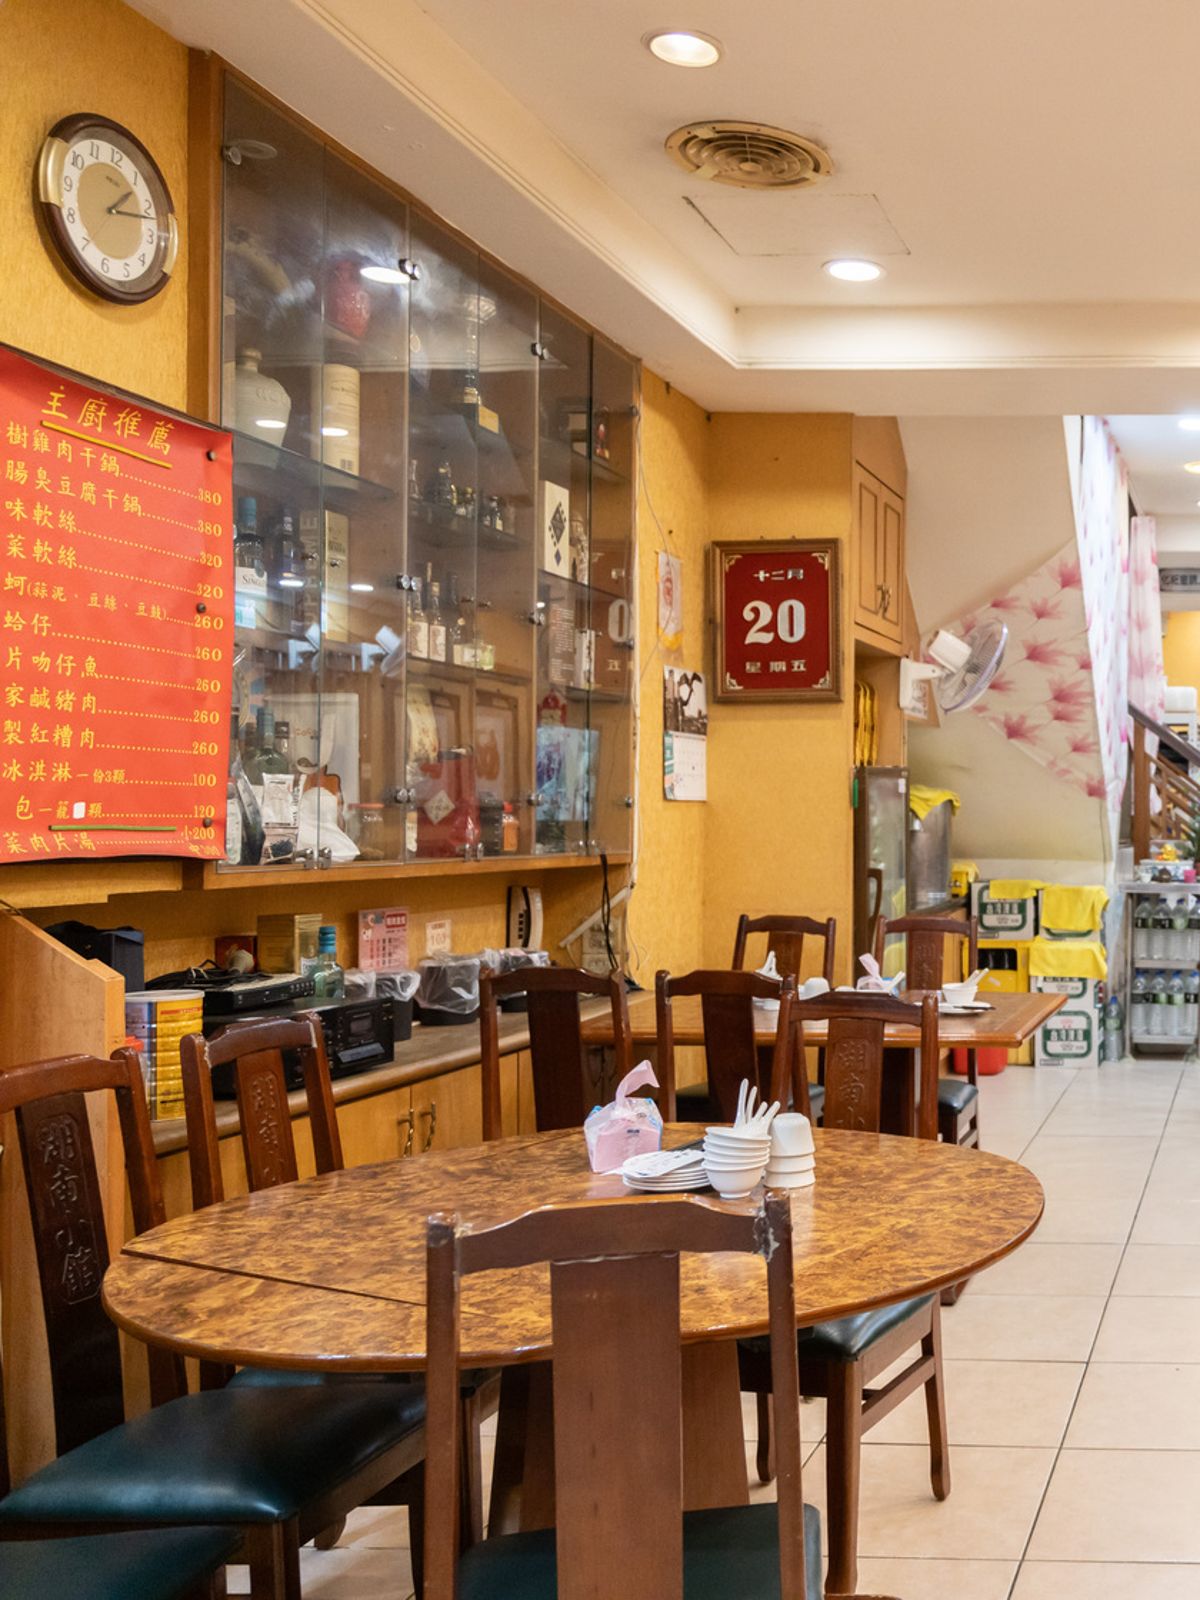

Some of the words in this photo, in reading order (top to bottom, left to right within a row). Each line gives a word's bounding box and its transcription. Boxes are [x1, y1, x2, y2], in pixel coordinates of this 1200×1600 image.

[89, 142, 100, 160] 11
[110, 148, 123, 168] 12
[71, 151, 84, 170] 10
[64, 176, 73, 191] 9
[132, 171, 138, 186] 1
[67, 207, 75, 224] 8
[144, 200, 151, 215] 2
[81, 237, 90, 251] 7
[147, 229, 154, 245] 3
[101, 258, 110, 273] 6
[138, 253, 146, 267] 4
[122, 263, 130, 278] 5
[6, 422, 120, 478] 樹雞肉干鍋
[198, 488, 222, 506] 380
[5, 460, 143, 517] 腸臭豆腐干鍋
[197, 519, 222, 537] 380
[5, 498, 78, 534] 味軟絲
[199, 551, 223, 568] 320
[6, 534, 78, 569] 菜軟絲
[197, 583, 223, 600] 320
[753, 569, 804, 582] 十二月
[194, 615, 223, 630] 260
[742, 599, 806, 645] 20
[4, 610, 51, 637] 蛤仔
[194, 647, 222, 662] 260
[5, 647, 99, 679] 片吻仔魚
[195, 678, 221, 693] 260
[745, 660, 807, 673] 星期五
[4, 682, 97, 714] 家鹹豬肉
[193, 710, 220, 725] 260
[3, 719, 95, 748] 製紅糟肉
[192, 742, 218, 756] 260
[193, 774, 216, 787] 100
[193, 804, 215, 818] 120
[3, 831, 97, 854] 菜肉片湯
